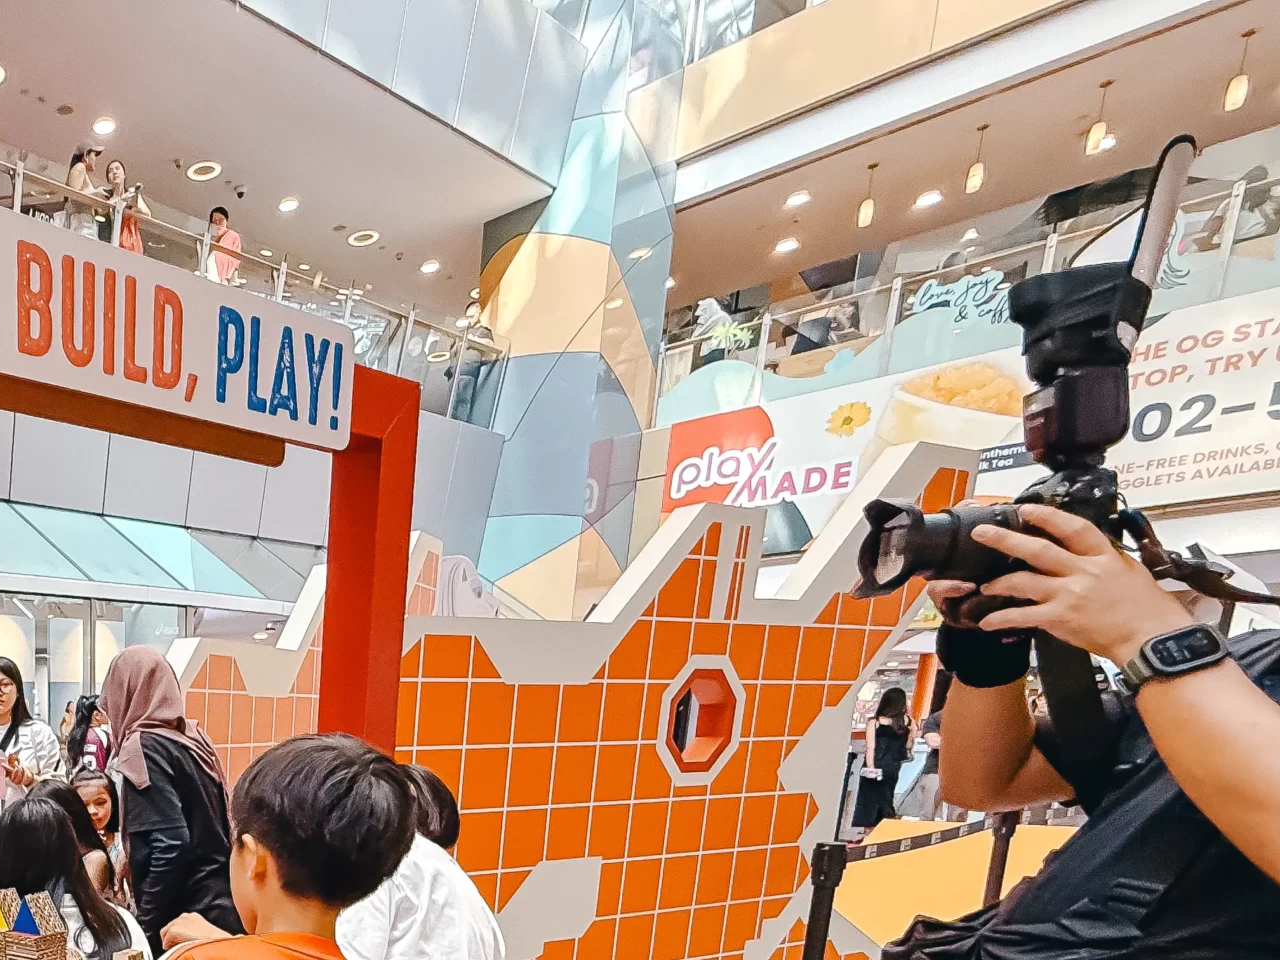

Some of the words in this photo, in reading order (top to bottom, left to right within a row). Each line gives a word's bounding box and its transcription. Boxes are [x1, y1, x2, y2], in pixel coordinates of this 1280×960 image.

[954, 304, 968, 323] &
[978, 295, 1010, 324] coff
[17, 240, 198, 402] BUILD,
[215, 305, 343, 431] PLAY!
[1131, 340, 1169, 364] HE
[1176, 330, 1224, 354] OG
[1205, 348, 1268, 376] TRY
[992, 457, 1014, 469] Tea
[1114, 453, 1189, 475] NE-FREE
[1192, 442, 1269, 464] DRINKS,
[732, 460, 852, 504] MADE
[1119, 471, 1186, 490] GGLETS
